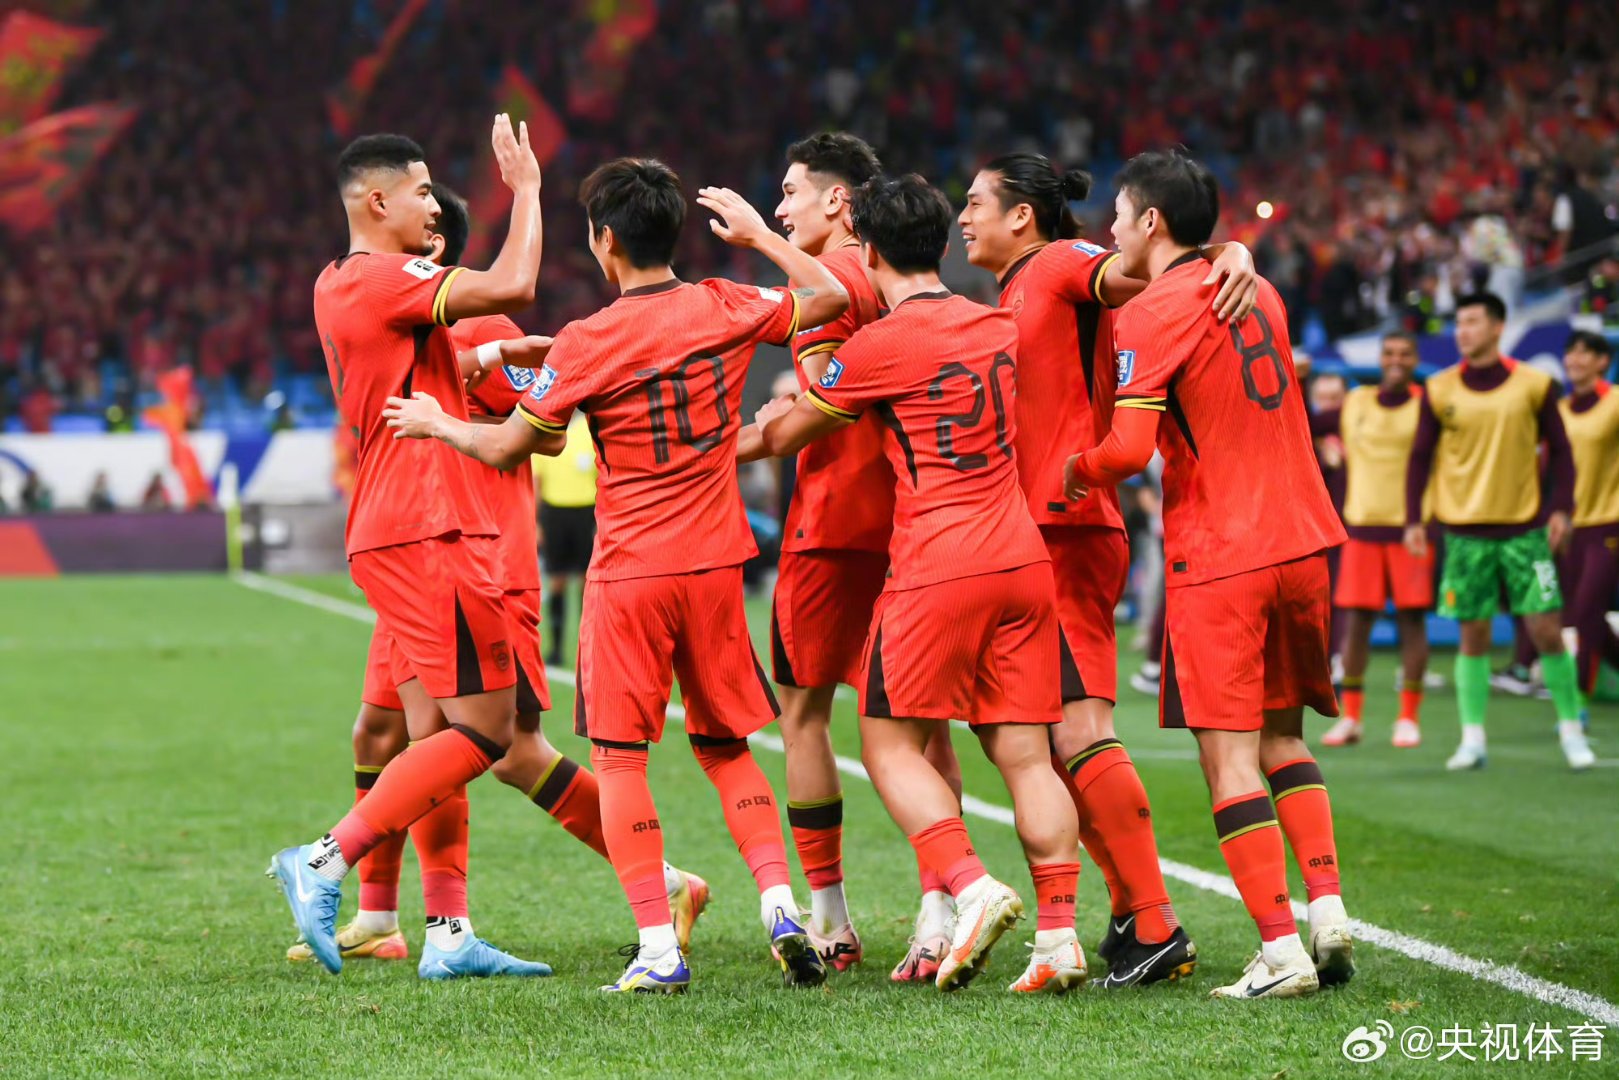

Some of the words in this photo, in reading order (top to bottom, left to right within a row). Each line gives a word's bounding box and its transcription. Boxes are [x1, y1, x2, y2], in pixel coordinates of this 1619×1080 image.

[1229, 306, 1288, 411] 8
[635, 351, 729, 463] 10
[928, 352, 1017, 470] 20
[737, 795, 771, 810] 中国
[632, 819, 660, 832] 中国
[1309, 855, 1334, 868] 中国
[1275, 893, 1289, 904] 中
